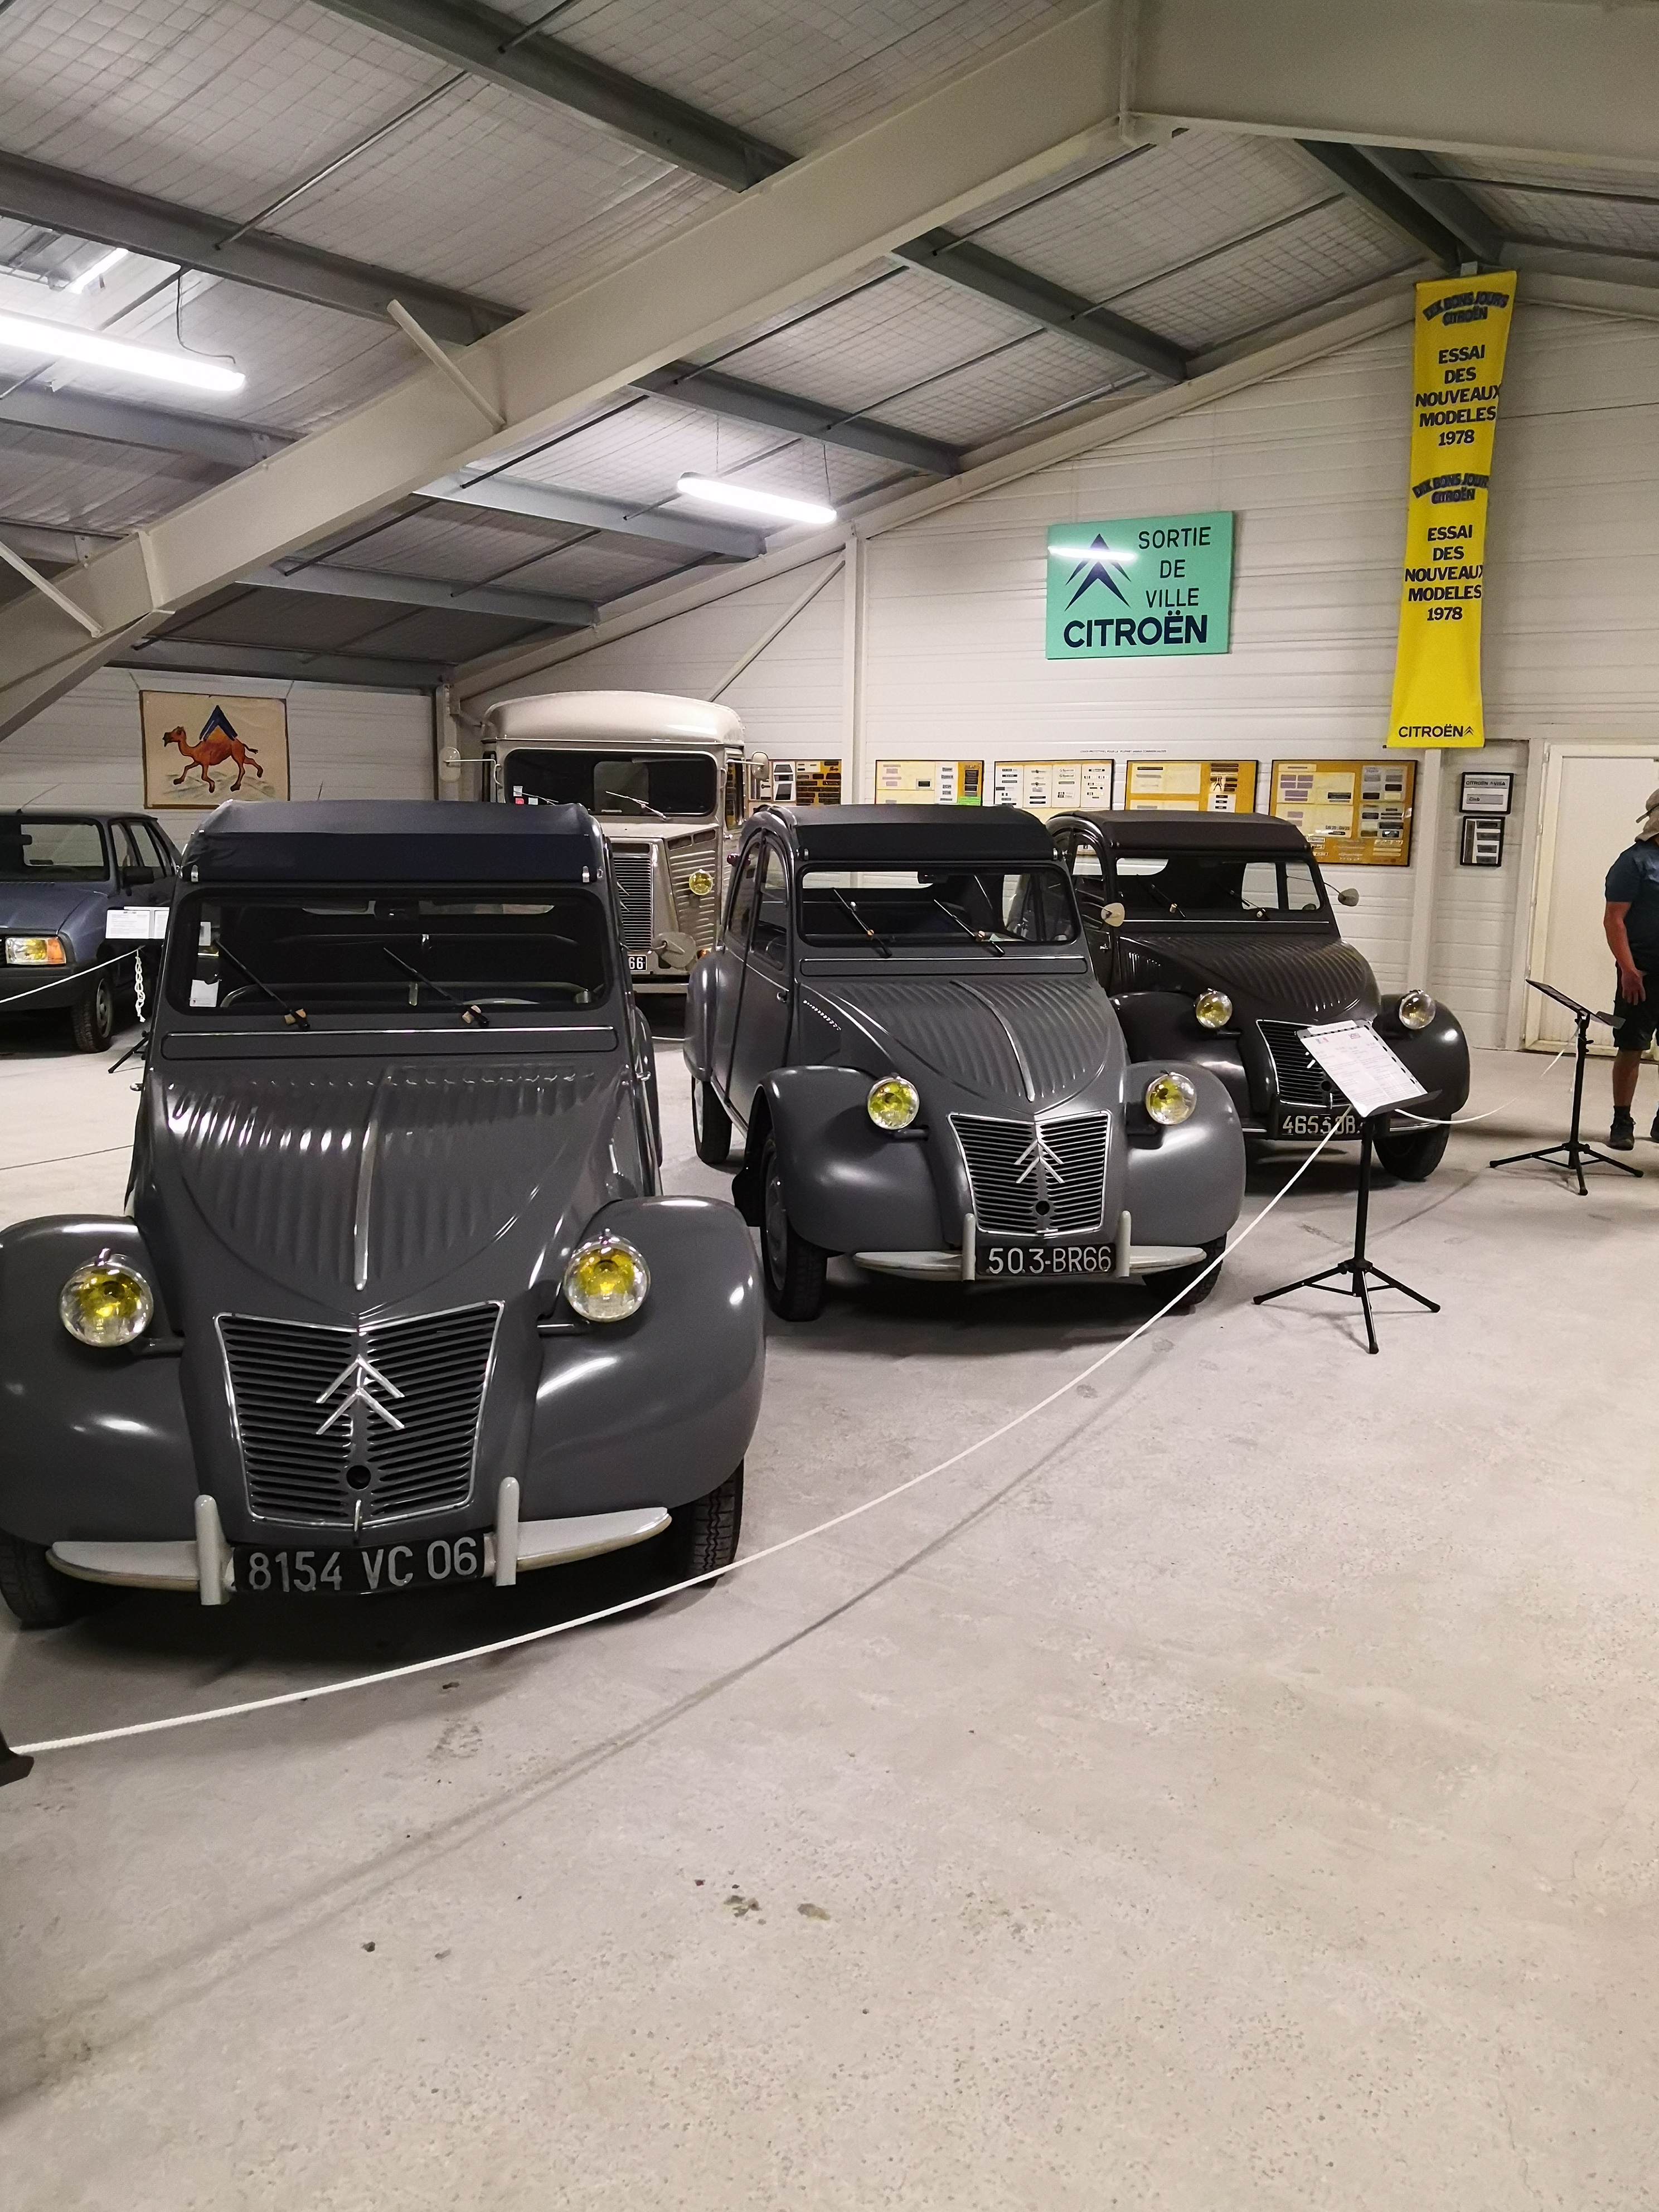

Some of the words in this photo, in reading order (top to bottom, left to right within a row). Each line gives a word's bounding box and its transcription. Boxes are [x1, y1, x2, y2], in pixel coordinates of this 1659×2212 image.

[1438, 345, 1485, 364] ESSAI
[1444, 367, 1476, 384] DES
[1415, 386, 1500, 407] NOUVEAUX
[1419, 406, 1496, 428] MODELES
[1438, 429, 1475, 447] 1978
[1431, 487, 1475, 504] CITROËN
[1138, 526, 1211, 549] SORTIE
[1427, 525, 1473, 541] ESSAI
[1433, 546, 1464, 561] DES
[1160, 559, 1186, 579] DE
[1146, 588, 1200, 608] VILLE
[1408, 584, 1482, 601] MODELES
[1427, 607, 1463, 621] 1978
[1064, 609, 1207, 648] CITROËN
[1398, 724, 1463, 738] CITROËN
[249, 1551, 343, 1593] 8154
[361, 1545, 414, 1589] VC
[427, 1536, 478, 1580] 06
